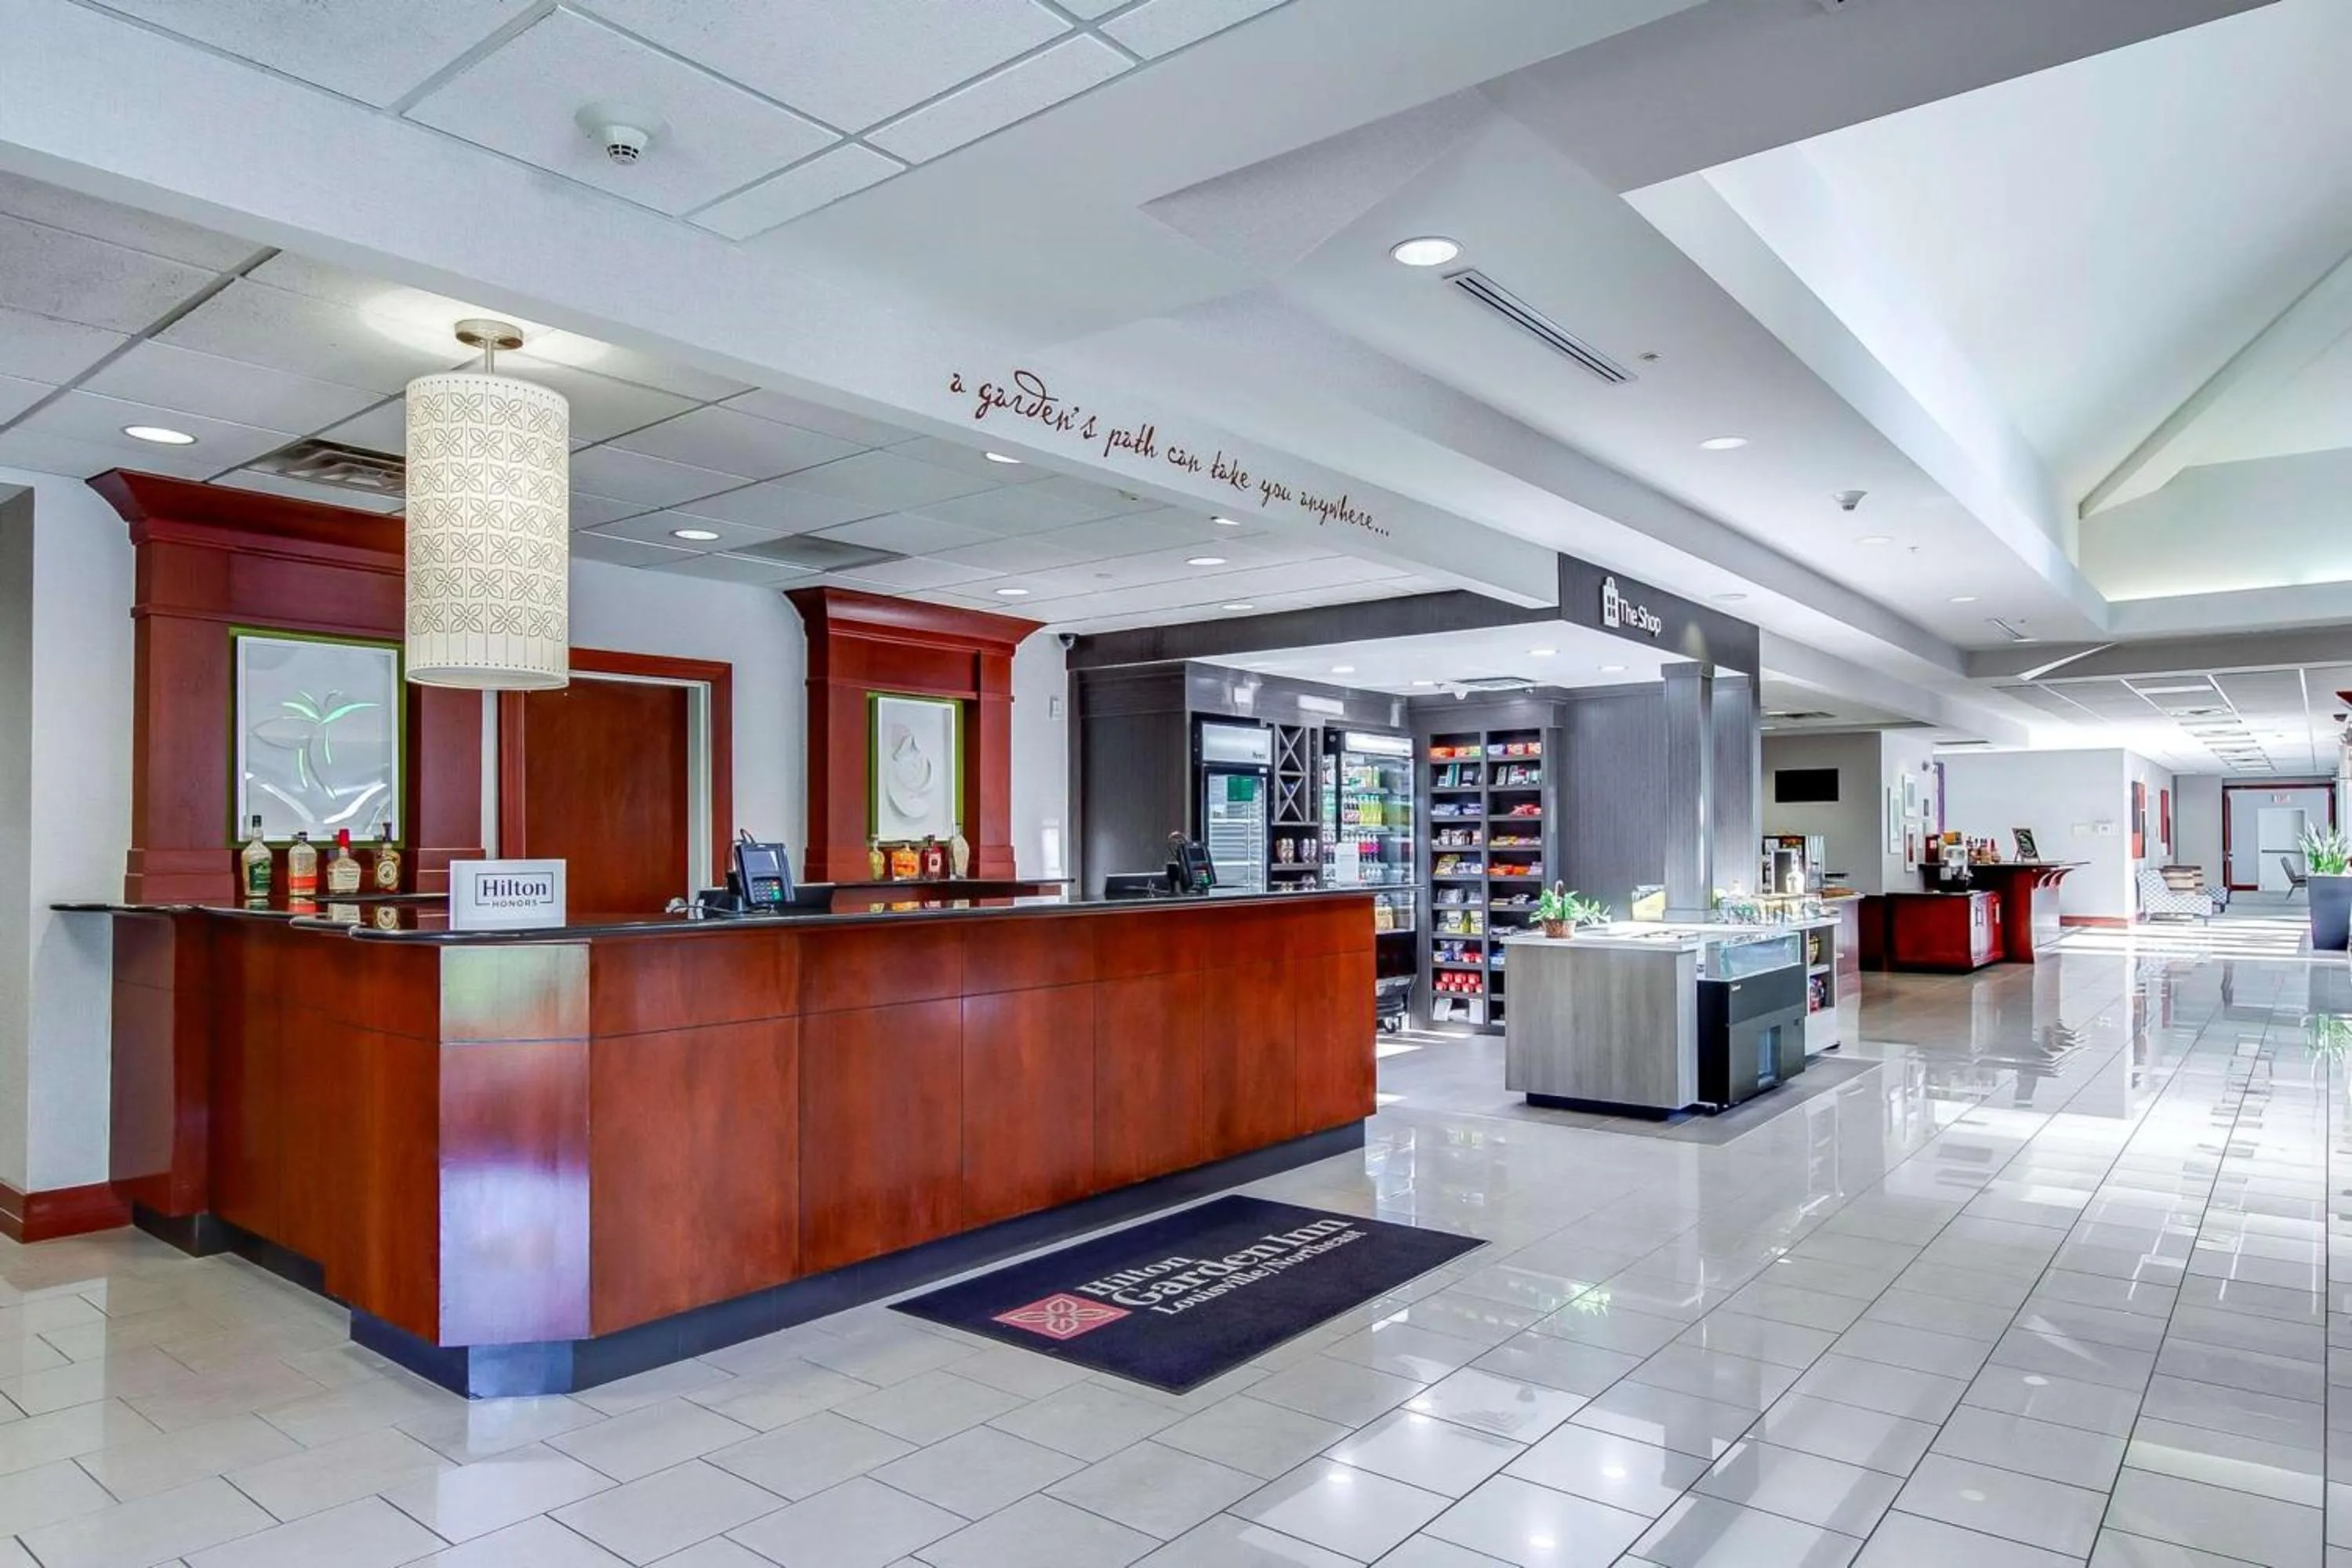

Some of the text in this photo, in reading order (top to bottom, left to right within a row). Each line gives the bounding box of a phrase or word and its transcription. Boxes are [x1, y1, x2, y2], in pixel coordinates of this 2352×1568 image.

[949, 370, 1390, 537] a garden's path can take you anywhere...
[1619, 598, 1661, 637] The Shop
[482, 879, 547, 897] Hilton
[491, 898, 539, 909] HONORS
[1075, 1256, 1196, 1297] Hilton
[1111, 1219, 1355, 1306] Garden Inn
